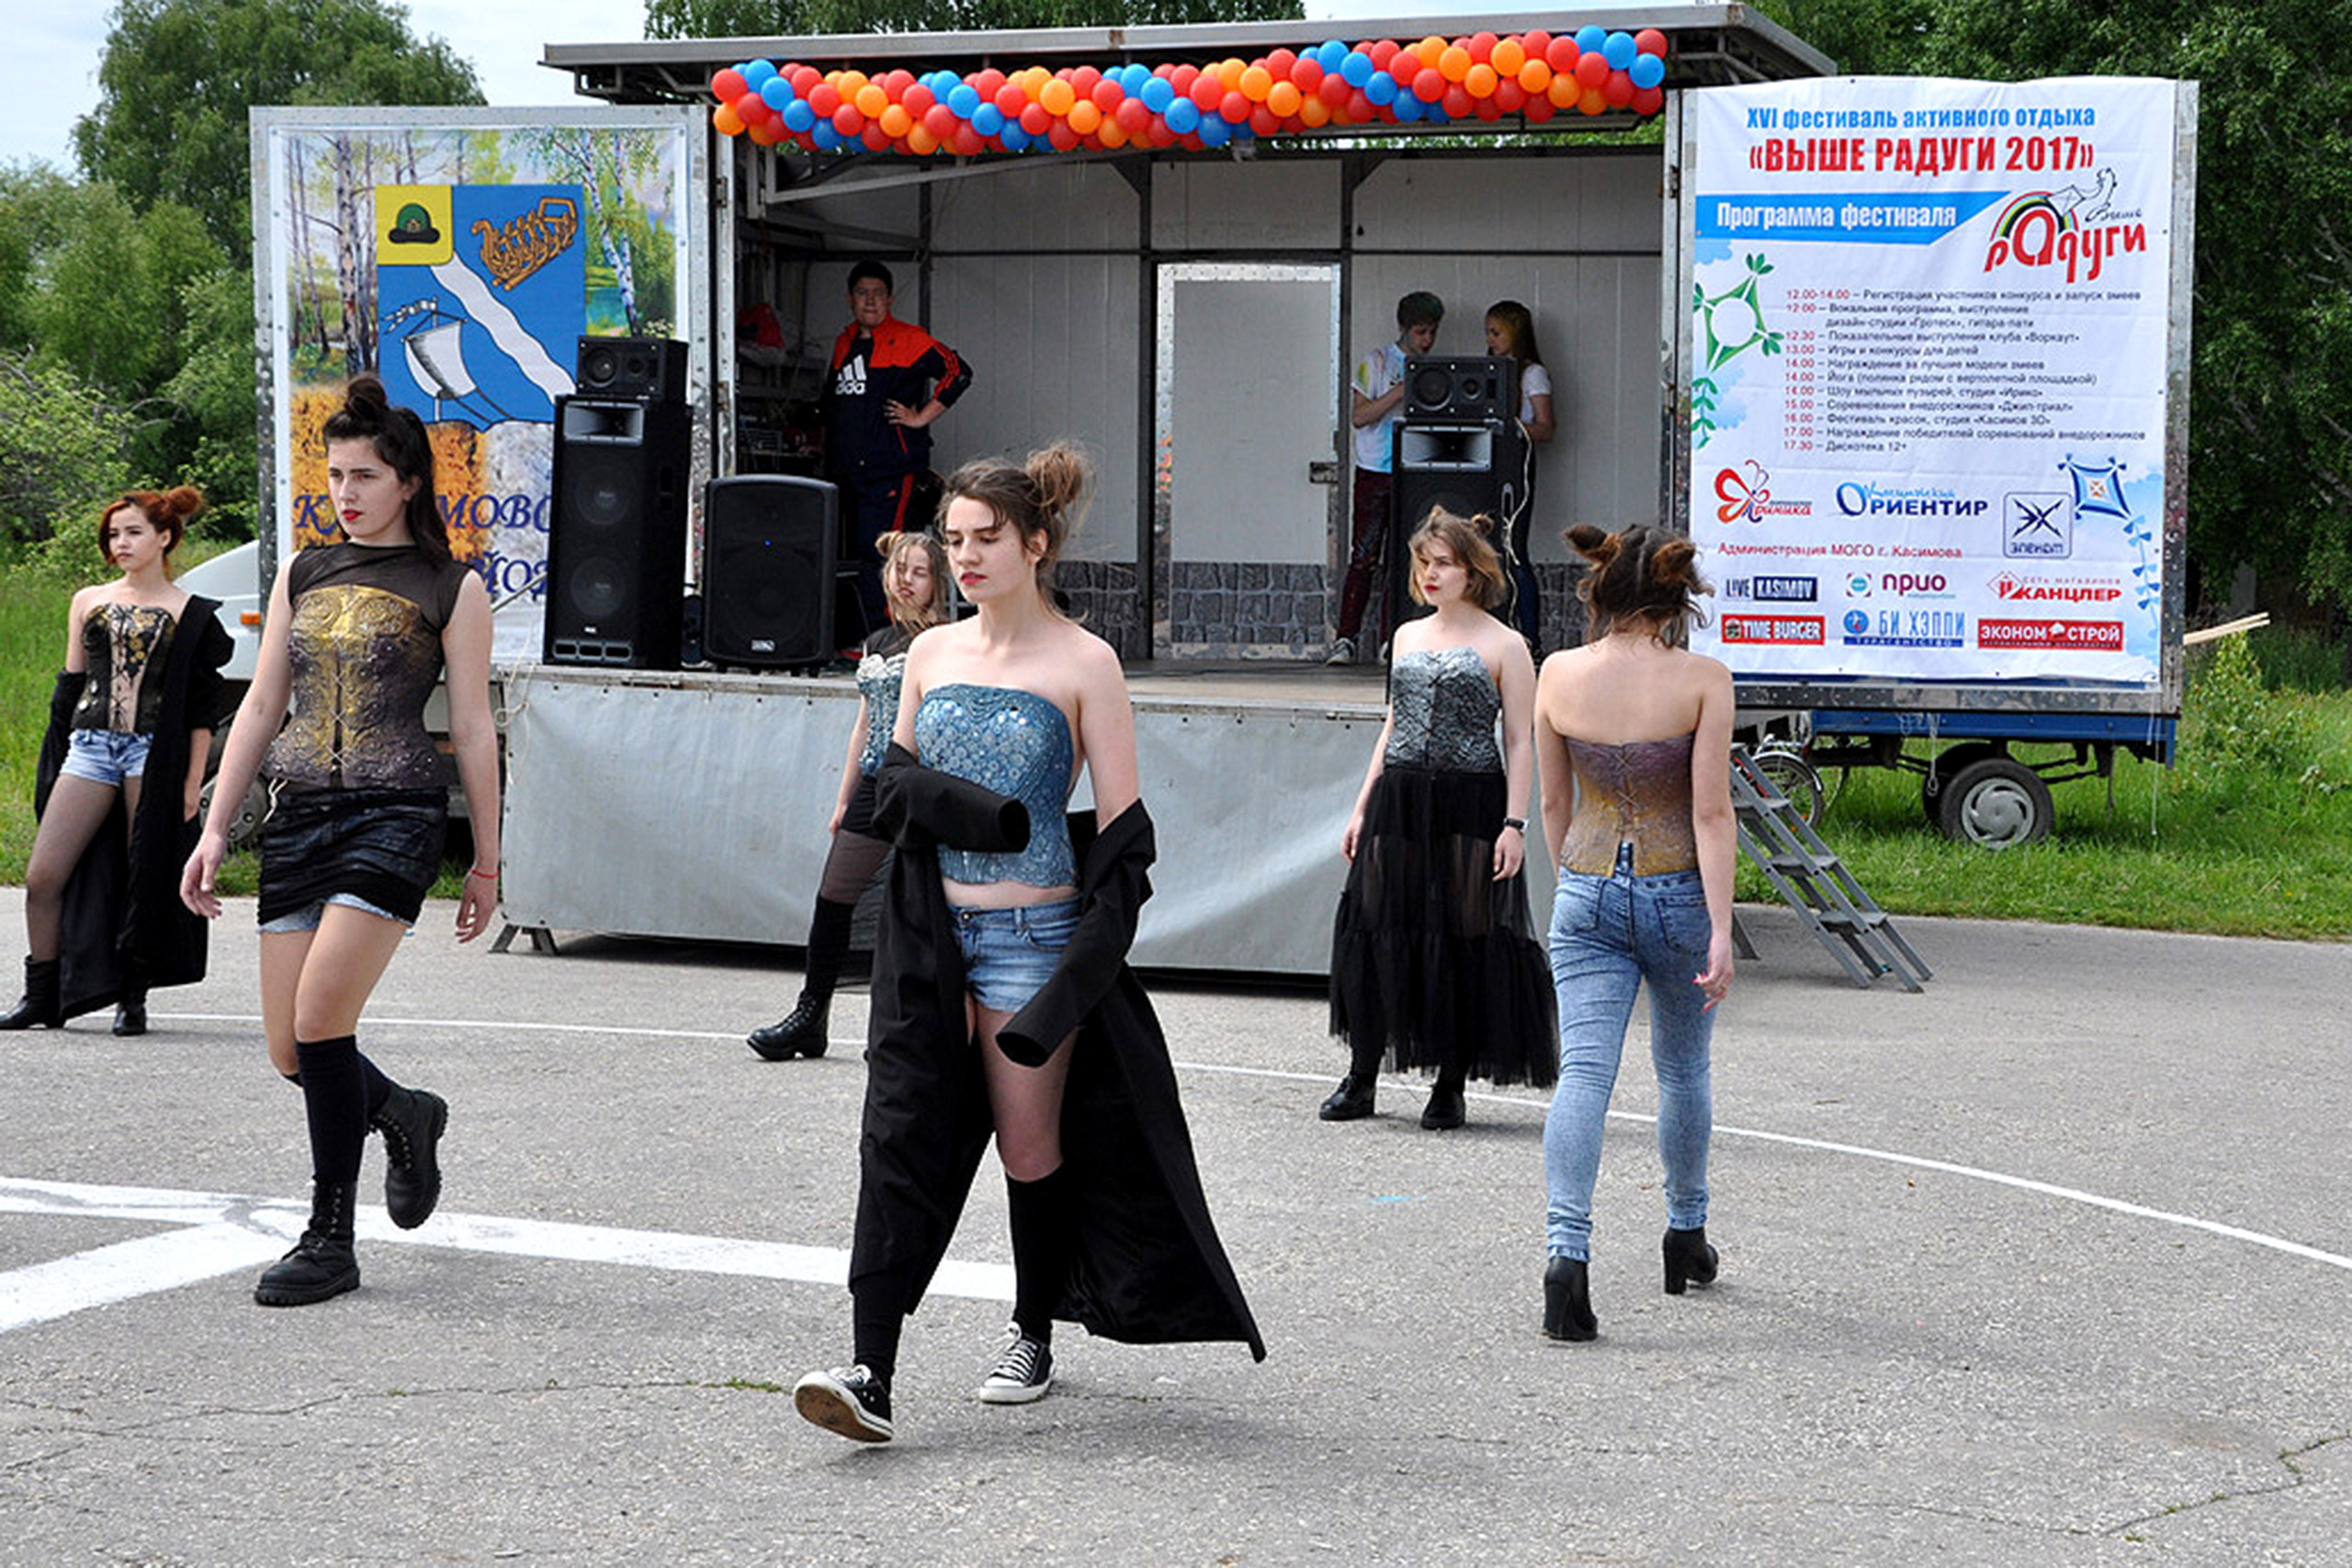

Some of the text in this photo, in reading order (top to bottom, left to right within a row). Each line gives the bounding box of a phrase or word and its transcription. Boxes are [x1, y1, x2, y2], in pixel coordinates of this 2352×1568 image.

[1747, 107, 2096, 131] XVI фестиваль активного отдыха
[1750, 137, 2094, 176] «ВЫШЕ РАДУГИ 2017»
[1717, 203, 1956, 229] Программа фестиваля
[1787, 288, 1850, 299] 12.00-14.00
[1863, 289, 1932, 301] Регистрация
[1936, 291, 1996, 302] участников
[2000, 291, 2052, 302] конкурса
[2065, 292, 2102, 302] запуск
[1786, 303, 1816, 313] 12.00
[1829, 303, 1888, 313] Вокальная
[1959, 305, 2029, 315] выступление
[1786, 330, 1815, 341] 12.30
[1828, 330, 1913, 342] Показательные
[1917, 333, 1985, 344] выступления
[1989, 332, 2021, 344] клуба
[1786, 344, 1815, 355] 13.00
[1828, 344, 1856, 356] Игры
[1870, 347, 1921, 356] конкурсы
[1923, 347, 1943, 356] для
[1946, 344, 1979, 356] детей
[1827, 359, 1902, 370] Награждение
[1905, 361, 1917, 369] за
[1921, 361, 1962, 371] лучшие
[1966, 361, 2007, 370] модели
[1786, 372, 1815, 382] 14.00
[1827, 370, 1854, 382] Йога
[1909, 375, 1944, 384] рядом
[1947, 374, 1953, 383] с
[1786, 385, 1815, 396] 14.00
[1827, 386, 1851, 398] Шоу
[1855, 388, 1903, 396] мыльных
[1959, 389, 1996, 399] студия
[1785, 399, 1815, 410] 15.00
[1827, 399, 1905, 412] Соревнования
[1909, 402, 1995, 412] внедорожников
[1784, 412, 1814, 423] 16.00
[1827, 413, 1886, 424] Фестиваль
[1934, 416, 1970, 426] студия
[1784, 426, 2145, 441] 17.00 Награждение победителей соревнований внедорожников
[1784, 440, 1813, 451] 17.30
[1826, 440, 1883, 452] Дискотека
[1837, 482, 1987, 515] ОРИЕНТИР
[1718, 542, 1826, 558] Администрация
[1832, 544, 1873, 557] МОГО
[1892, 545, 1962, 558] Касимова
[1726, 579, 1814, 599] LIVE KASIMOV
[2009, 587, 2122, 603] КАНЦЛЕР
[1742, 620, 1821, 640] TIME BURGER
[1879, 610, 1965, 637] БИ ХЭППИ
[1981, 626, 2120, 641] ЭКОНОМ СТРОЙ
